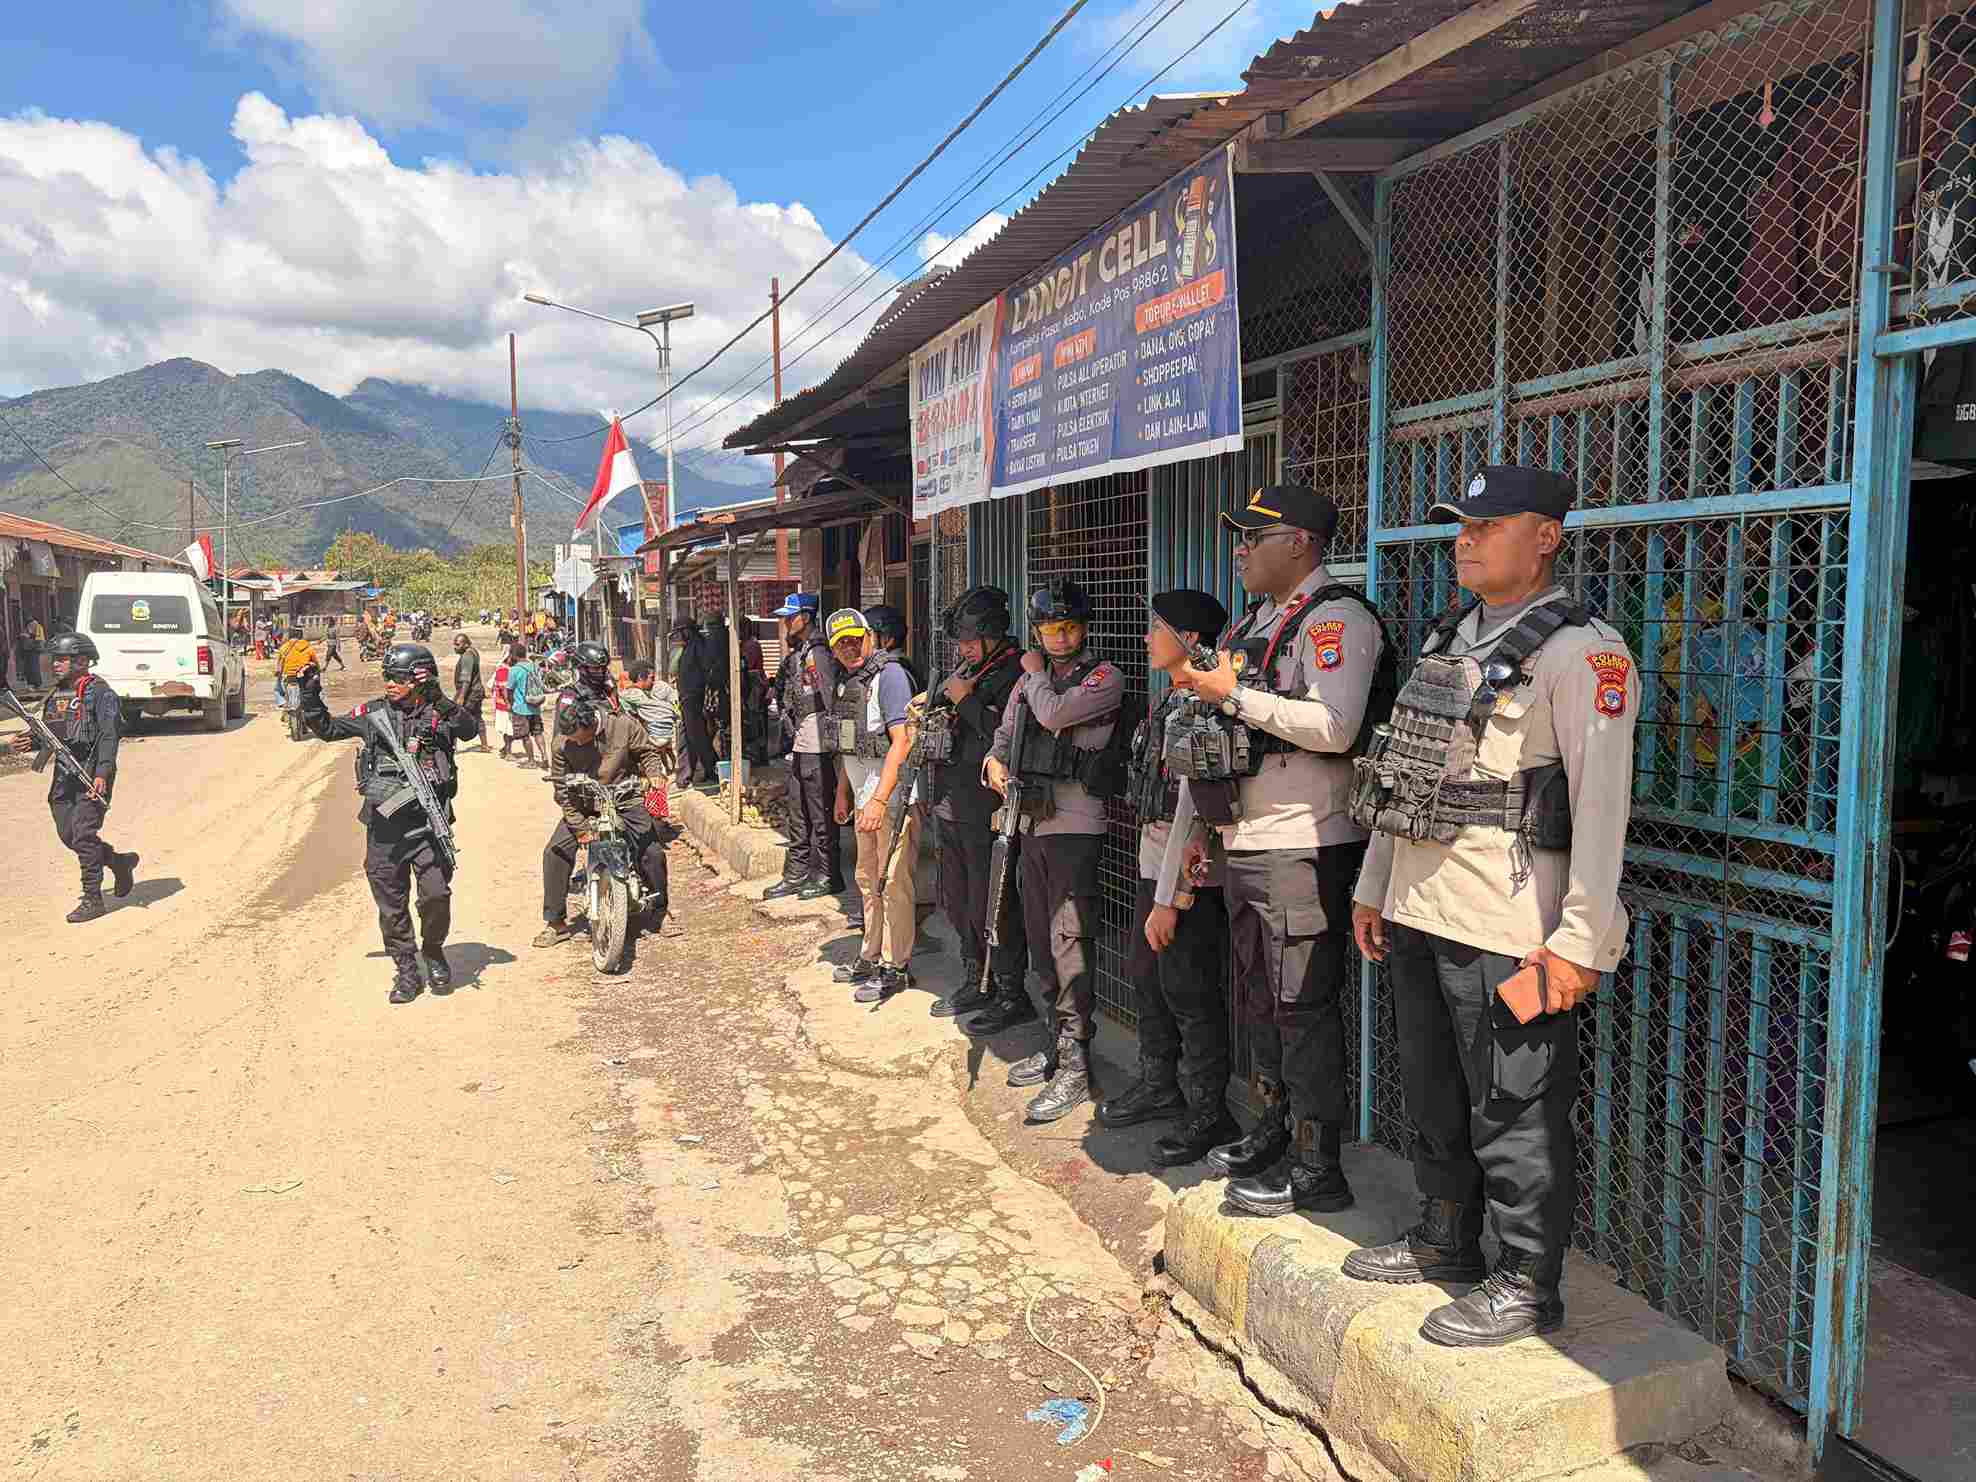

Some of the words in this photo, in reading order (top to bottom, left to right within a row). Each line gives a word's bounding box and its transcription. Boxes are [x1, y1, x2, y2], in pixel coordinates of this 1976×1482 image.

[1011, 251, 1092, 335] LANGIT
[1098, 210, 1167, 282] CELL
[1133, 264, 1168, 295] 98862
[1188, 318, 1215, 342] GOPAY
[951, 322, 981, 382] ATM
[1092, 350, 1127, 378] OPERATOR
[1143, 359, 1180, 386] SHOPPEE
[1144, 394, 1162, 415] LINK
[1165, 389, 1181, 408] AJA
[1163, 409, 1207, 436] LAIN-LAIN
